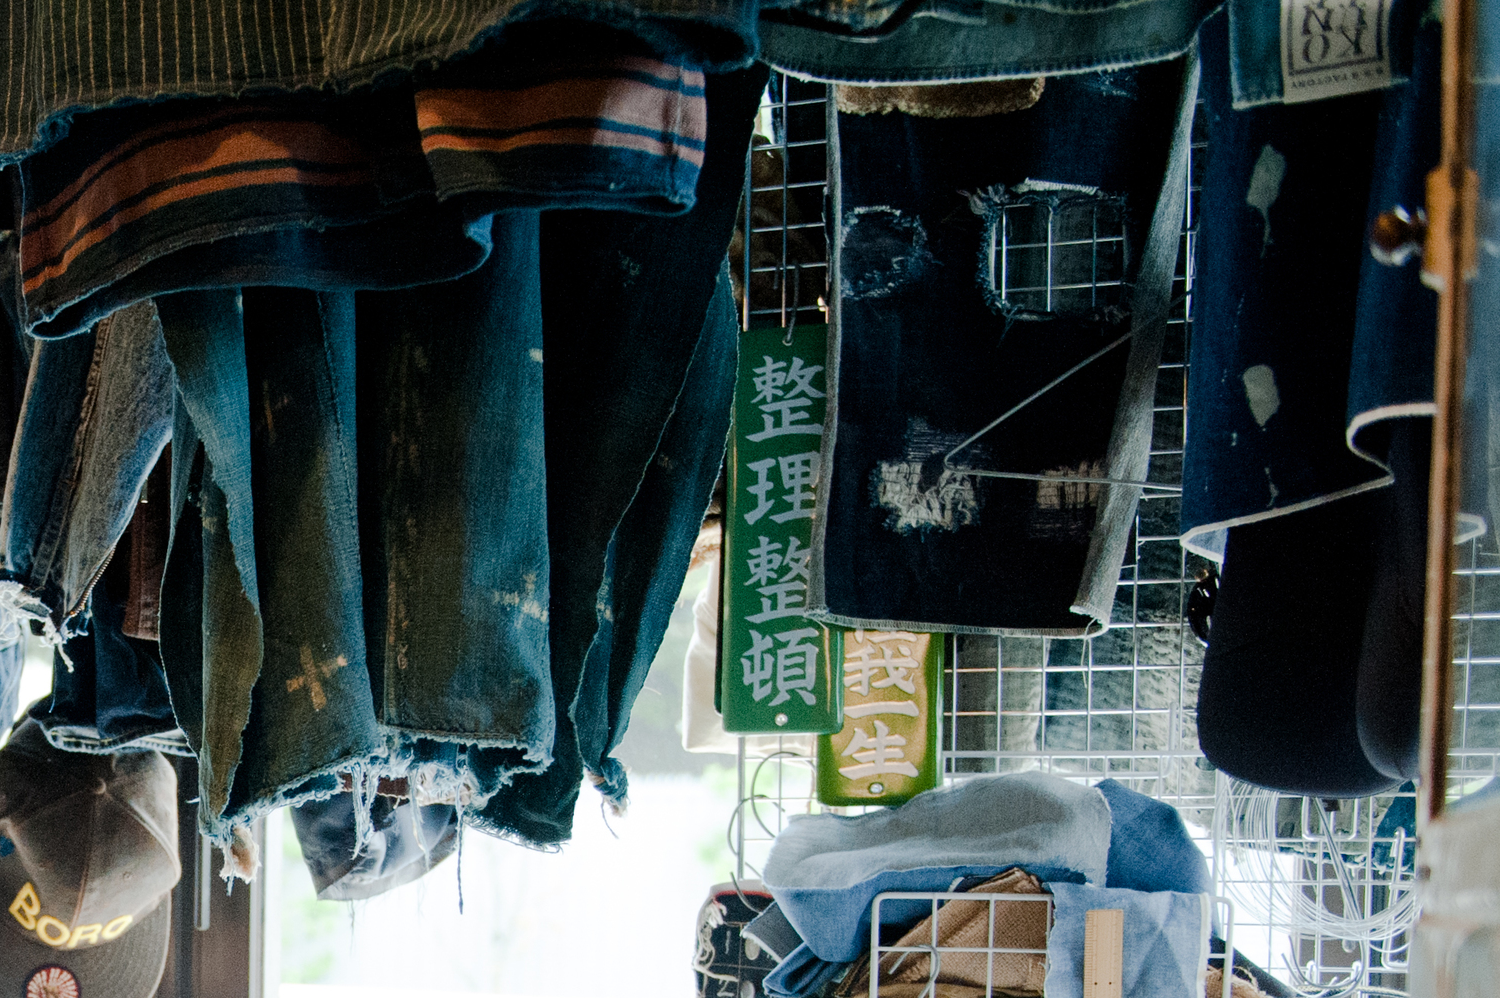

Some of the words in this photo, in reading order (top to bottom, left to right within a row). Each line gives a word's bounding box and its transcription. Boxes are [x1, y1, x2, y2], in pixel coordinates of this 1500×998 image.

[740, 355, 827, 706] 整理整頓
[8, 881, 134, 949] BORO
[723, 930, 731, 955] 1
[716, 978, 735, 998] 2
